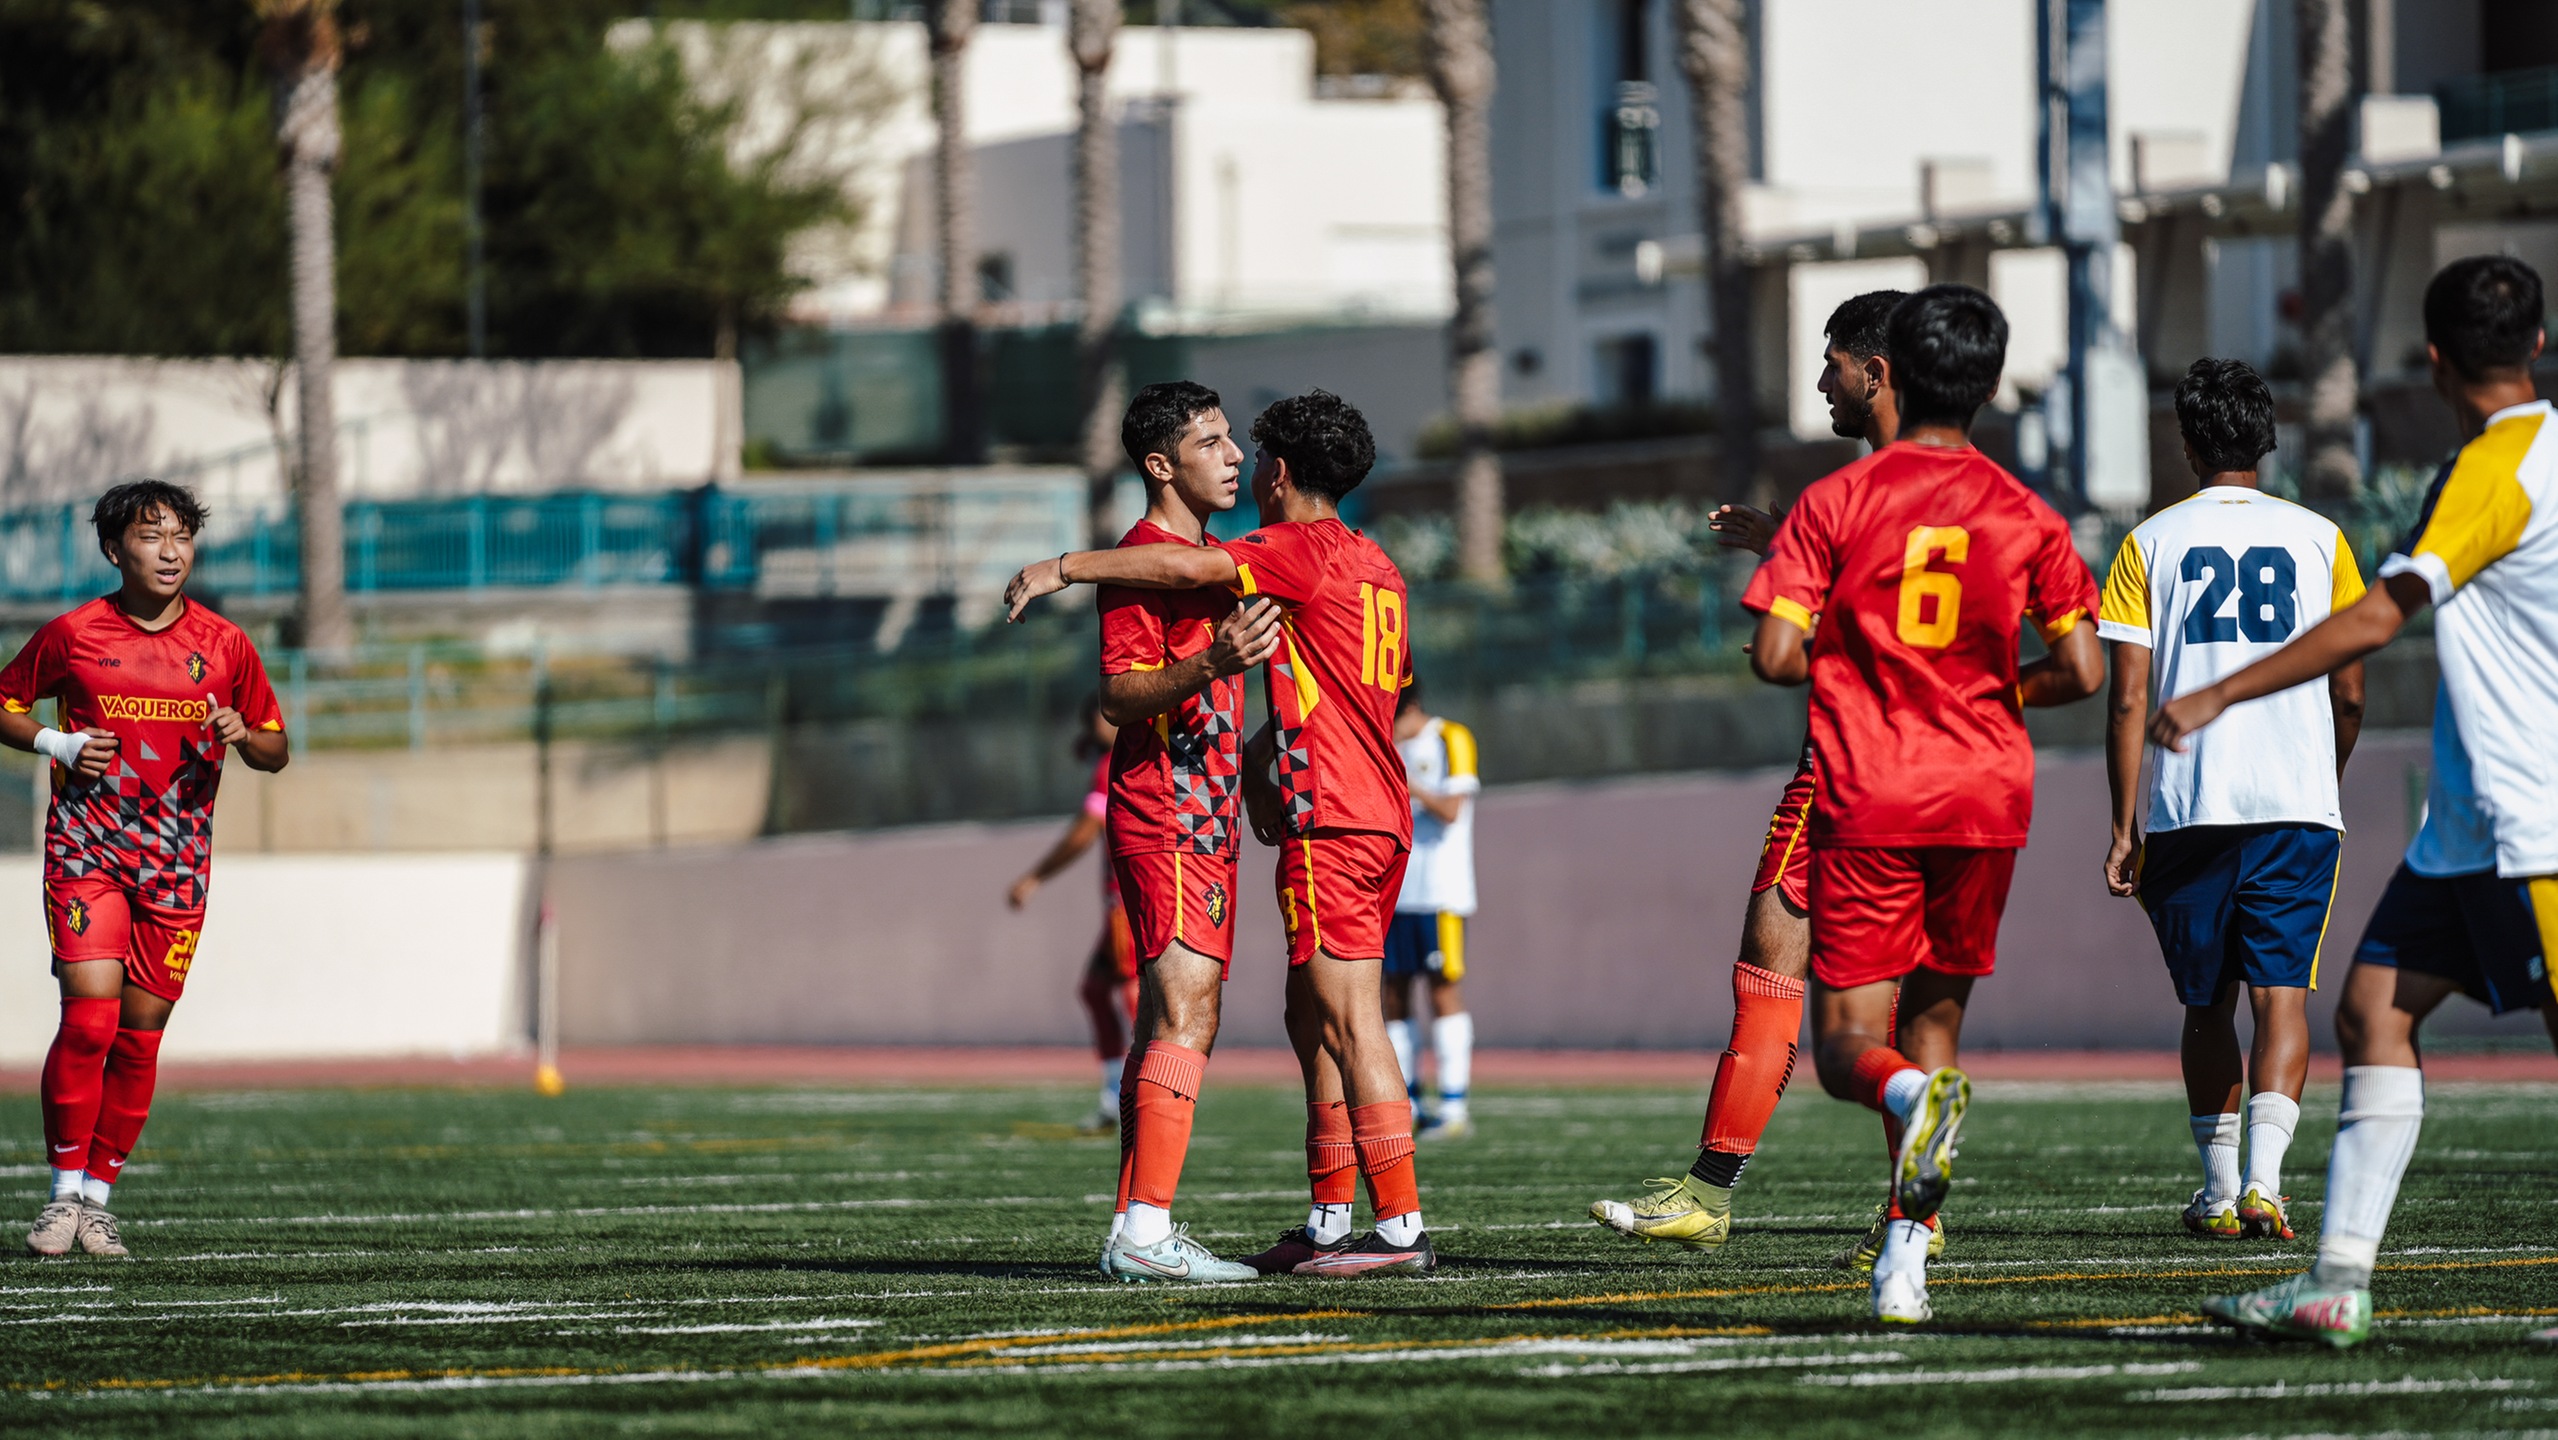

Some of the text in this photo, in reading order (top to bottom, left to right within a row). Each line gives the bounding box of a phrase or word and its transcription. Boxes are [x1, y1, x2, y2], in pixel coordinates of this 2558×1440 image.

[1359, 582, 1401, 694] 18
[1896, 525, 1970, 649] 6
[2180, 546, 2297, 644] 28
[97, 694, 207, 722] VAQUEROS
